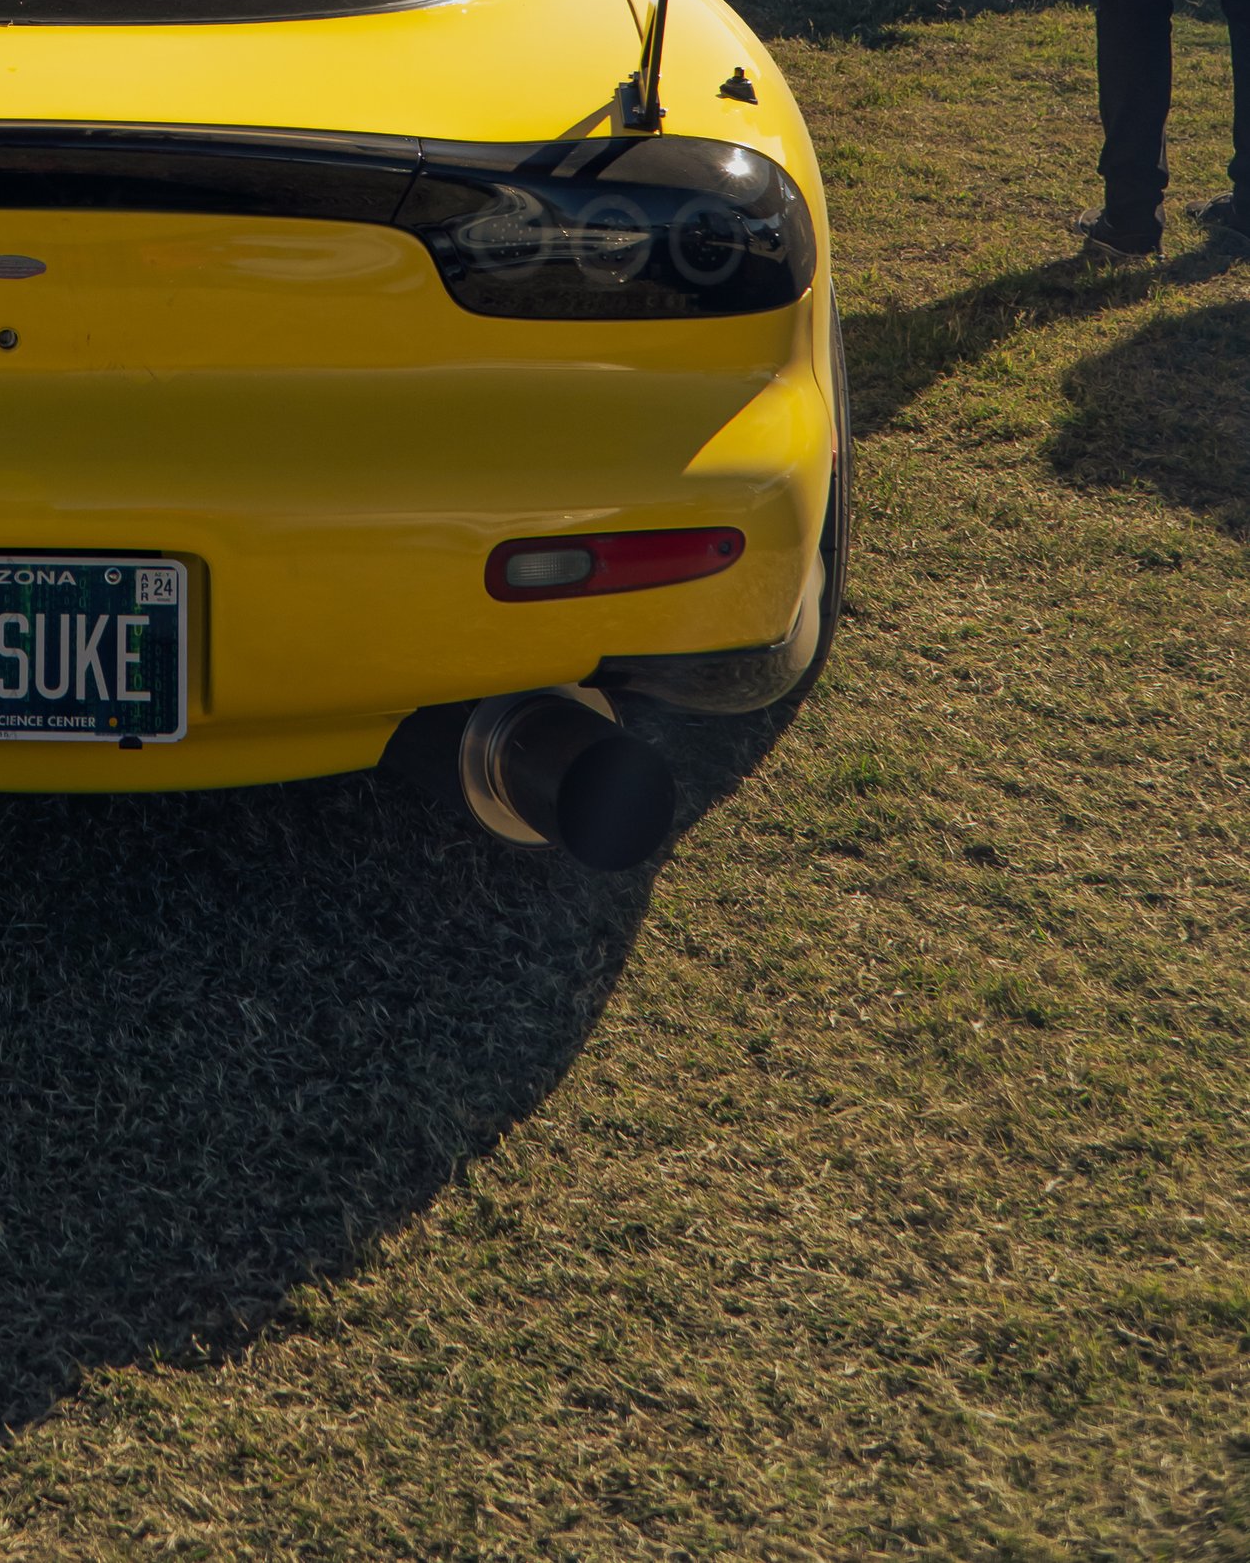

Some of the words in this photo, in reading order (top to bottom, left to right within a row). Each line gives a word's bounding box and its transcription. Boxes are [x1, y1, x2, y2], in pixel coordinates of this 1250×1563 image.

[141, 573, 149, 601] APR
[153, 578, 173, 596] 24
[47, 716, 96, 728] CENTER
